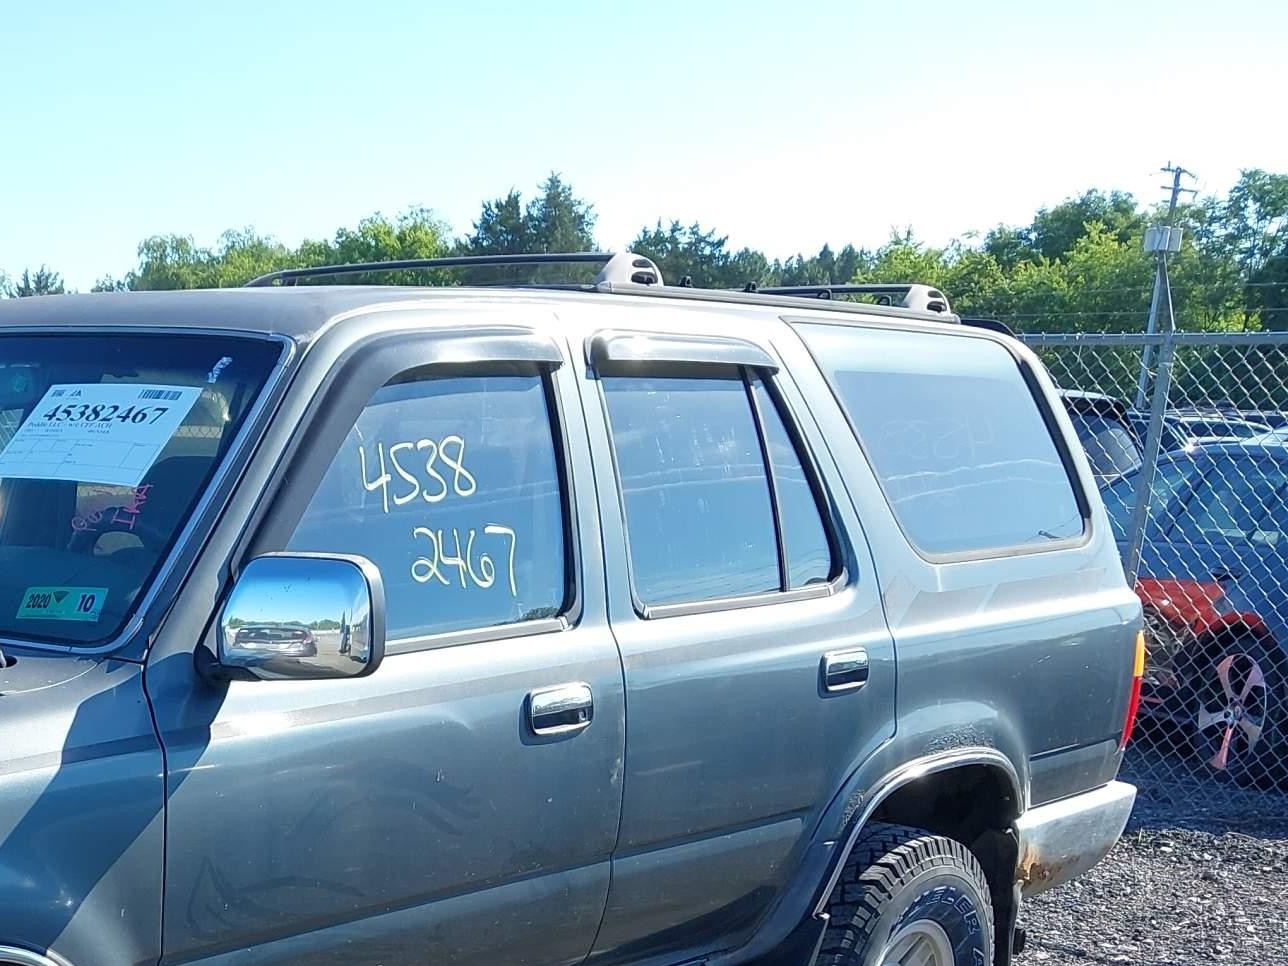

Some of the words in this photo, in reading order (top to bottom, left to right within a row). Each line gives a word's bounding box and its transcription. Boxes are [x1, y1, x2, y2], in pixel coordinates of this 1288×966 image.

[43, 404, 169, 425] 45382467
[359, 436, 476, 513] 4538
[412, 523, 516, 596] 2467
[25, 593, 52, 609] 2020
[77, 593, 96, 613] 10
